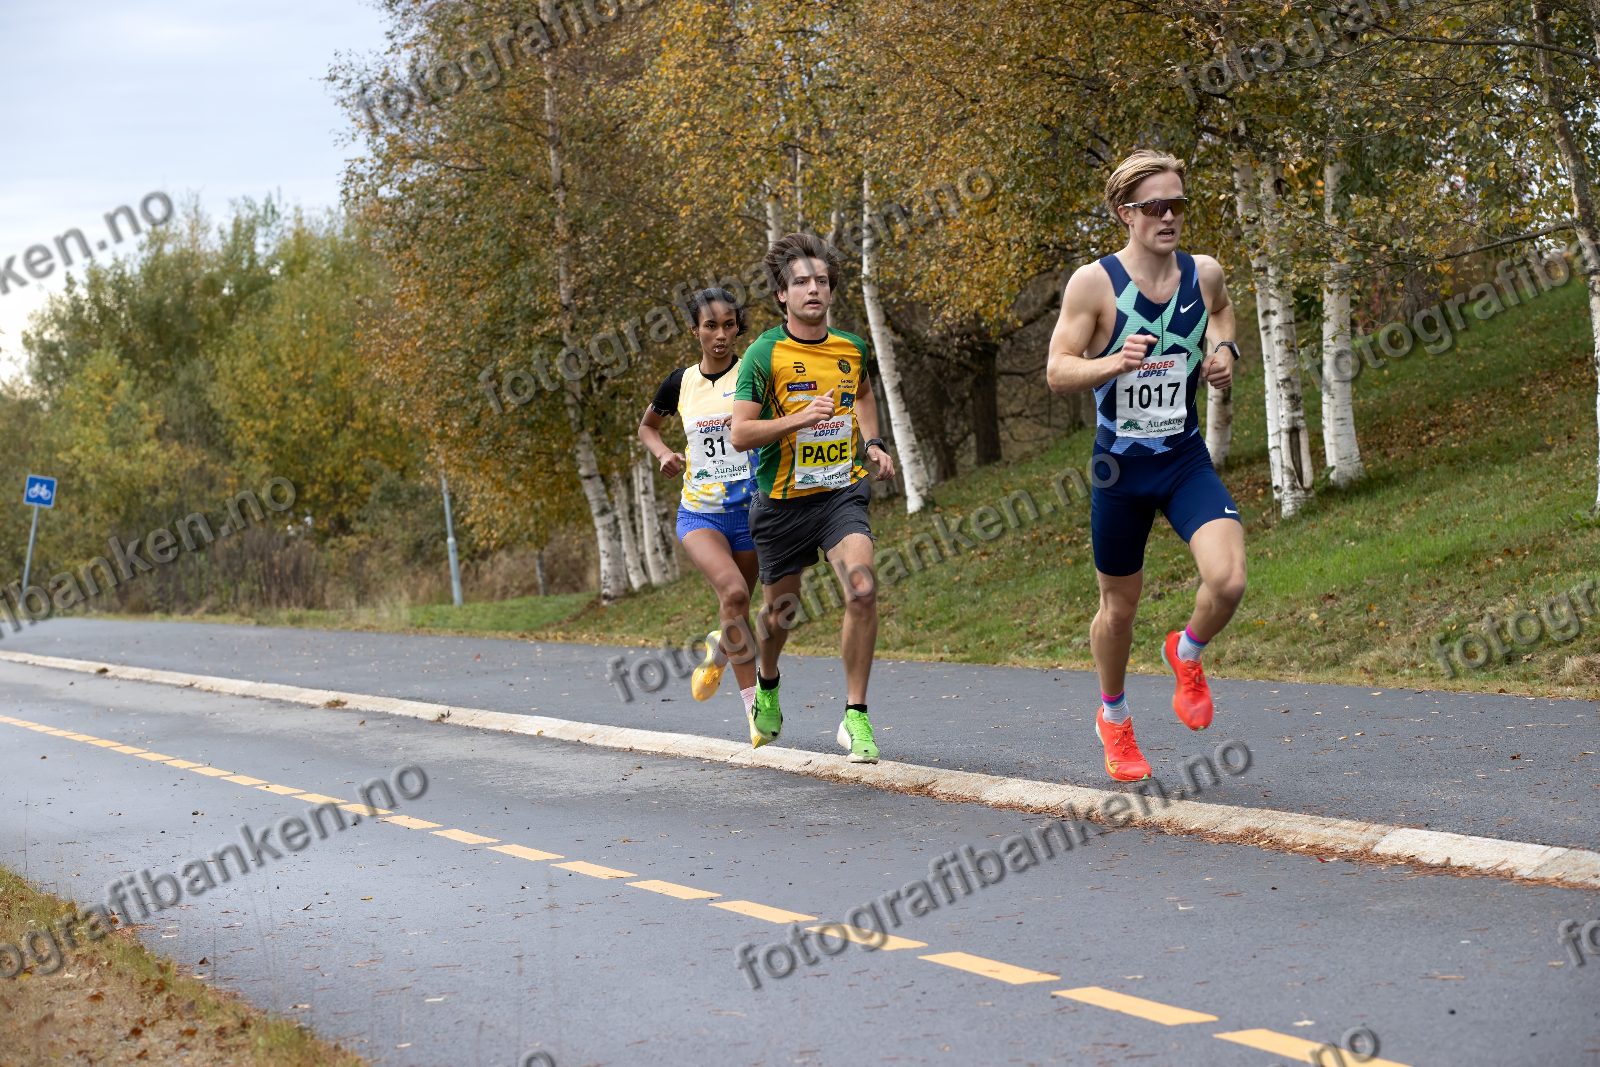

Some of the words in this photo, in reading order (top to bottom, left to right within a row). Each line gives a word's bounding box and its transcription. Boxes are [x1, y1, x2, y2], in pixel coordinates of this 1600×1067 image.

[1137, 369, 1168, 378] LØPET
[1124, 382, 1181, 409] 1017
[696, 419, 726, 428] NORG
[700, 425, 725, 433] LØPET
[703, 436, 726, 457] 31
[802, 442, 848, 463] PACE
[715, 465, 747, 475] Aurskog
